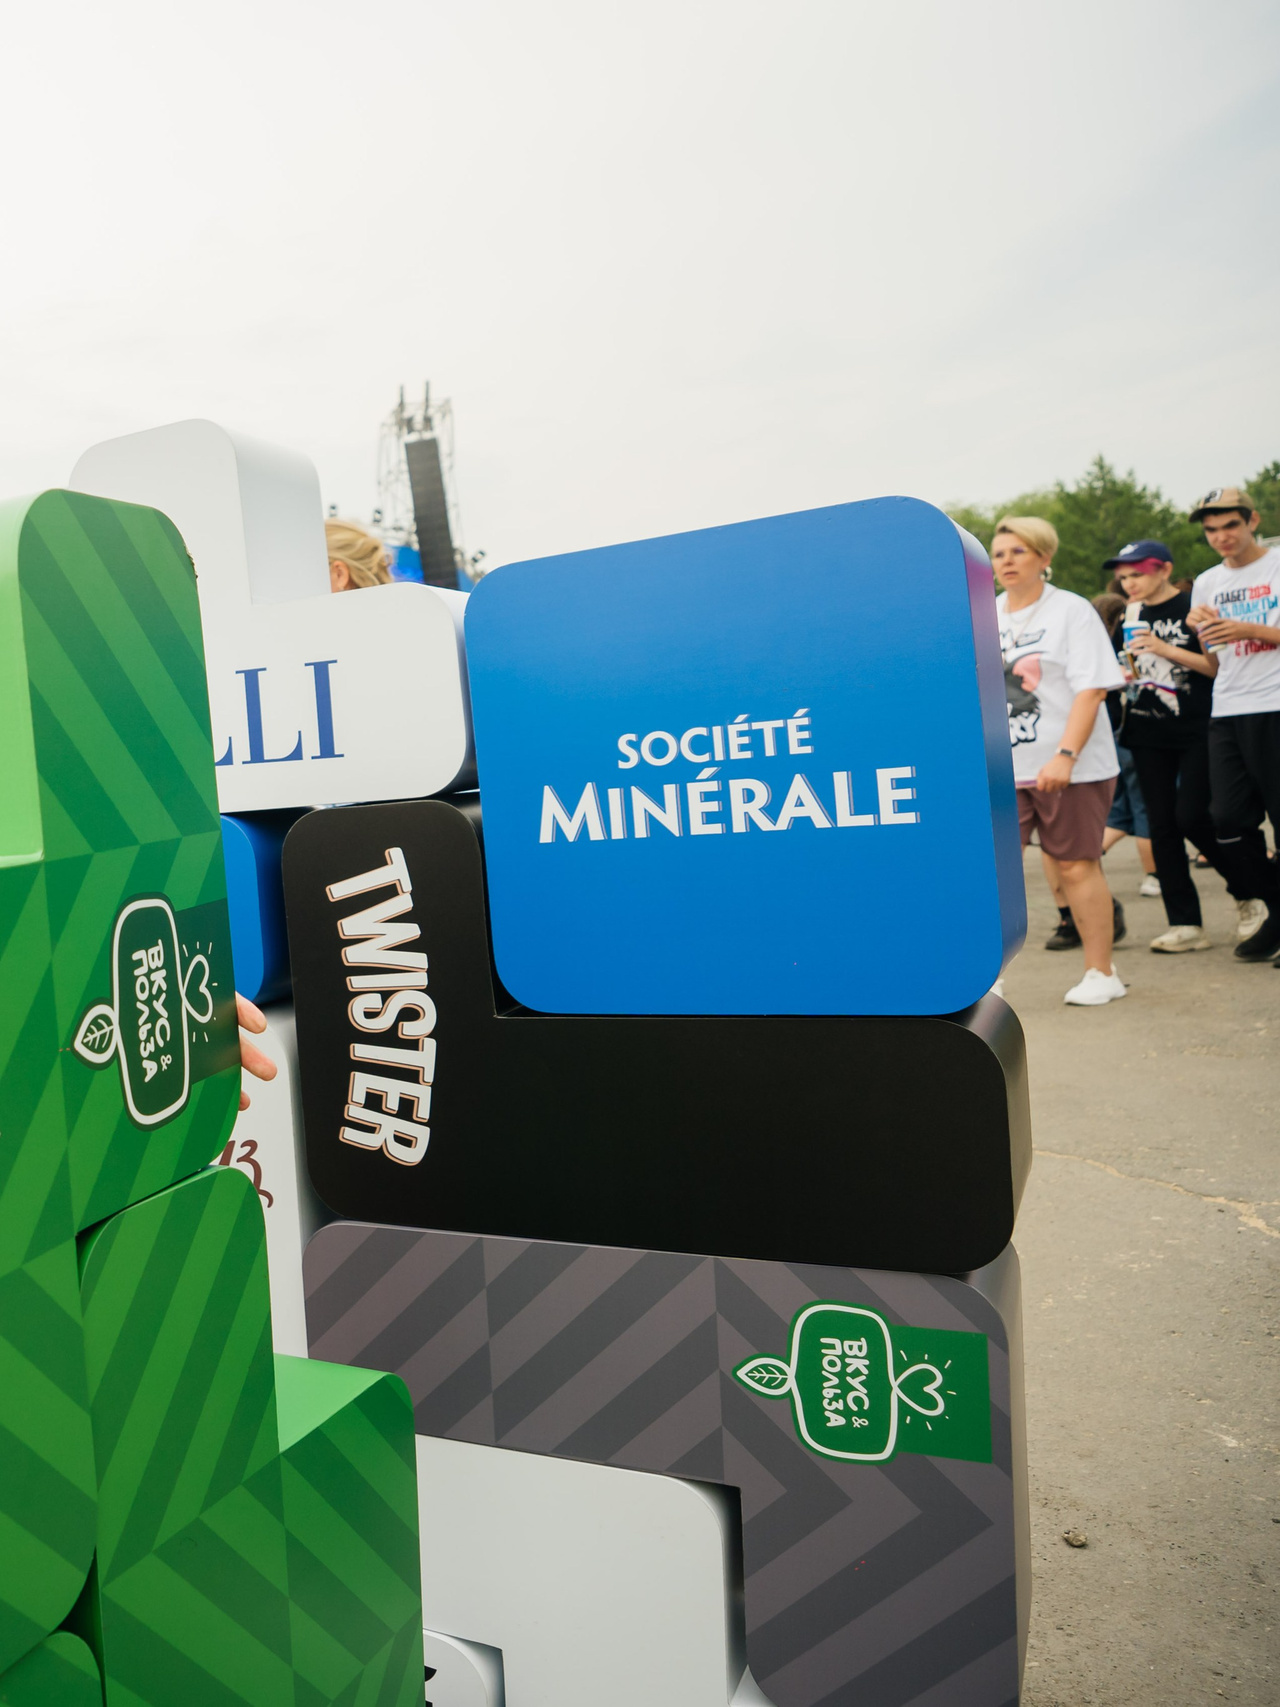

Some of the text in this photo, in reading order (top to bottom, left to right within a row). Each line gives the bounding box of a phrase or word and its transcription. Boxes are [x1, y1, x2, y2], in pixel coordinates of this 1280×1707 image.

[617, 708, 814, 770] SOCIÉTÉ
[539, 766, 920, 844] MINÉRALE
[132, 949, 158, 1083] ПОЛЬЗА
[147, 939, 172, 1072] ВКУС &
[325, 847, 437, 1166] TWISTER
[820, 1337, 846, 1427] ПОЛЬЗА
[843, 1337, 870, 1428] ВКУС &
